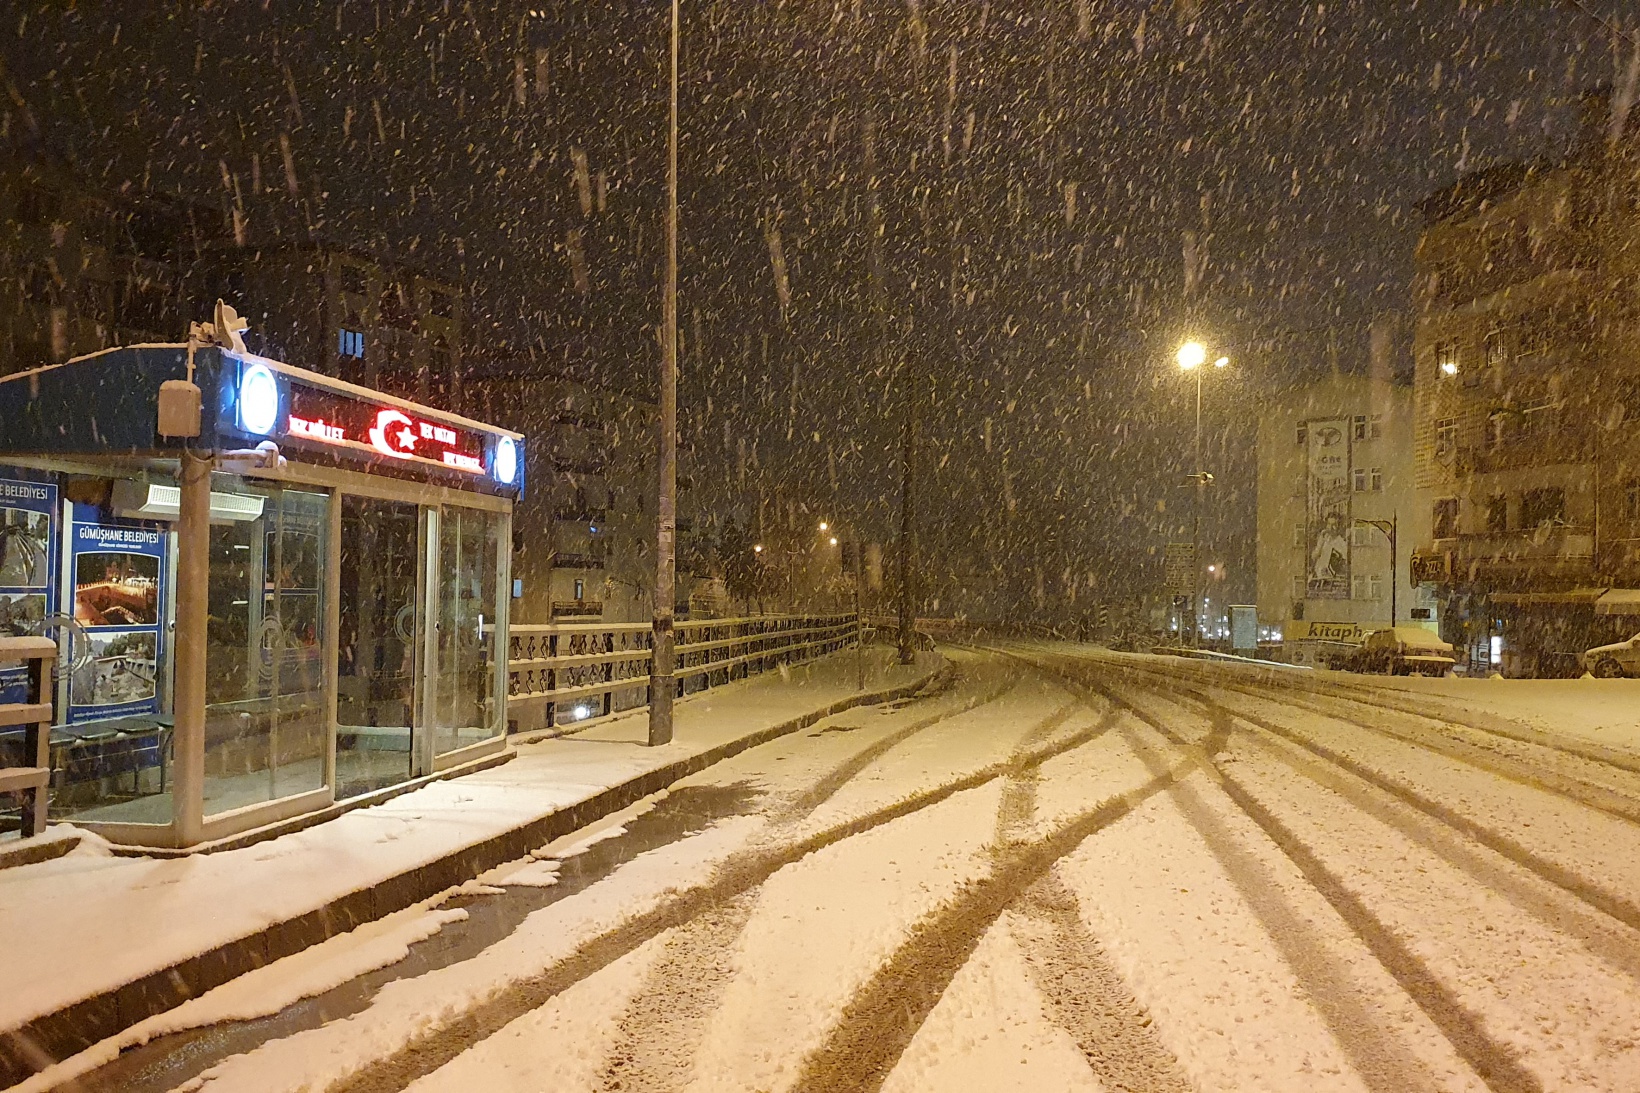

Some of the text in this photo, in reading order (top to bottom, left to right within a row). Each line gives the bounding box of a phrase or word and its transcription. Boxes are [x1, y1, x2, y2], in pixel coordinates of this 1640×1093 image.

[420, 422, 434, 439] TEK
[5, 484, 48, 500] BELEDİYESİ
[79, 525, 159, 544] GÜMÜŞHANE BELEDİYESİ
